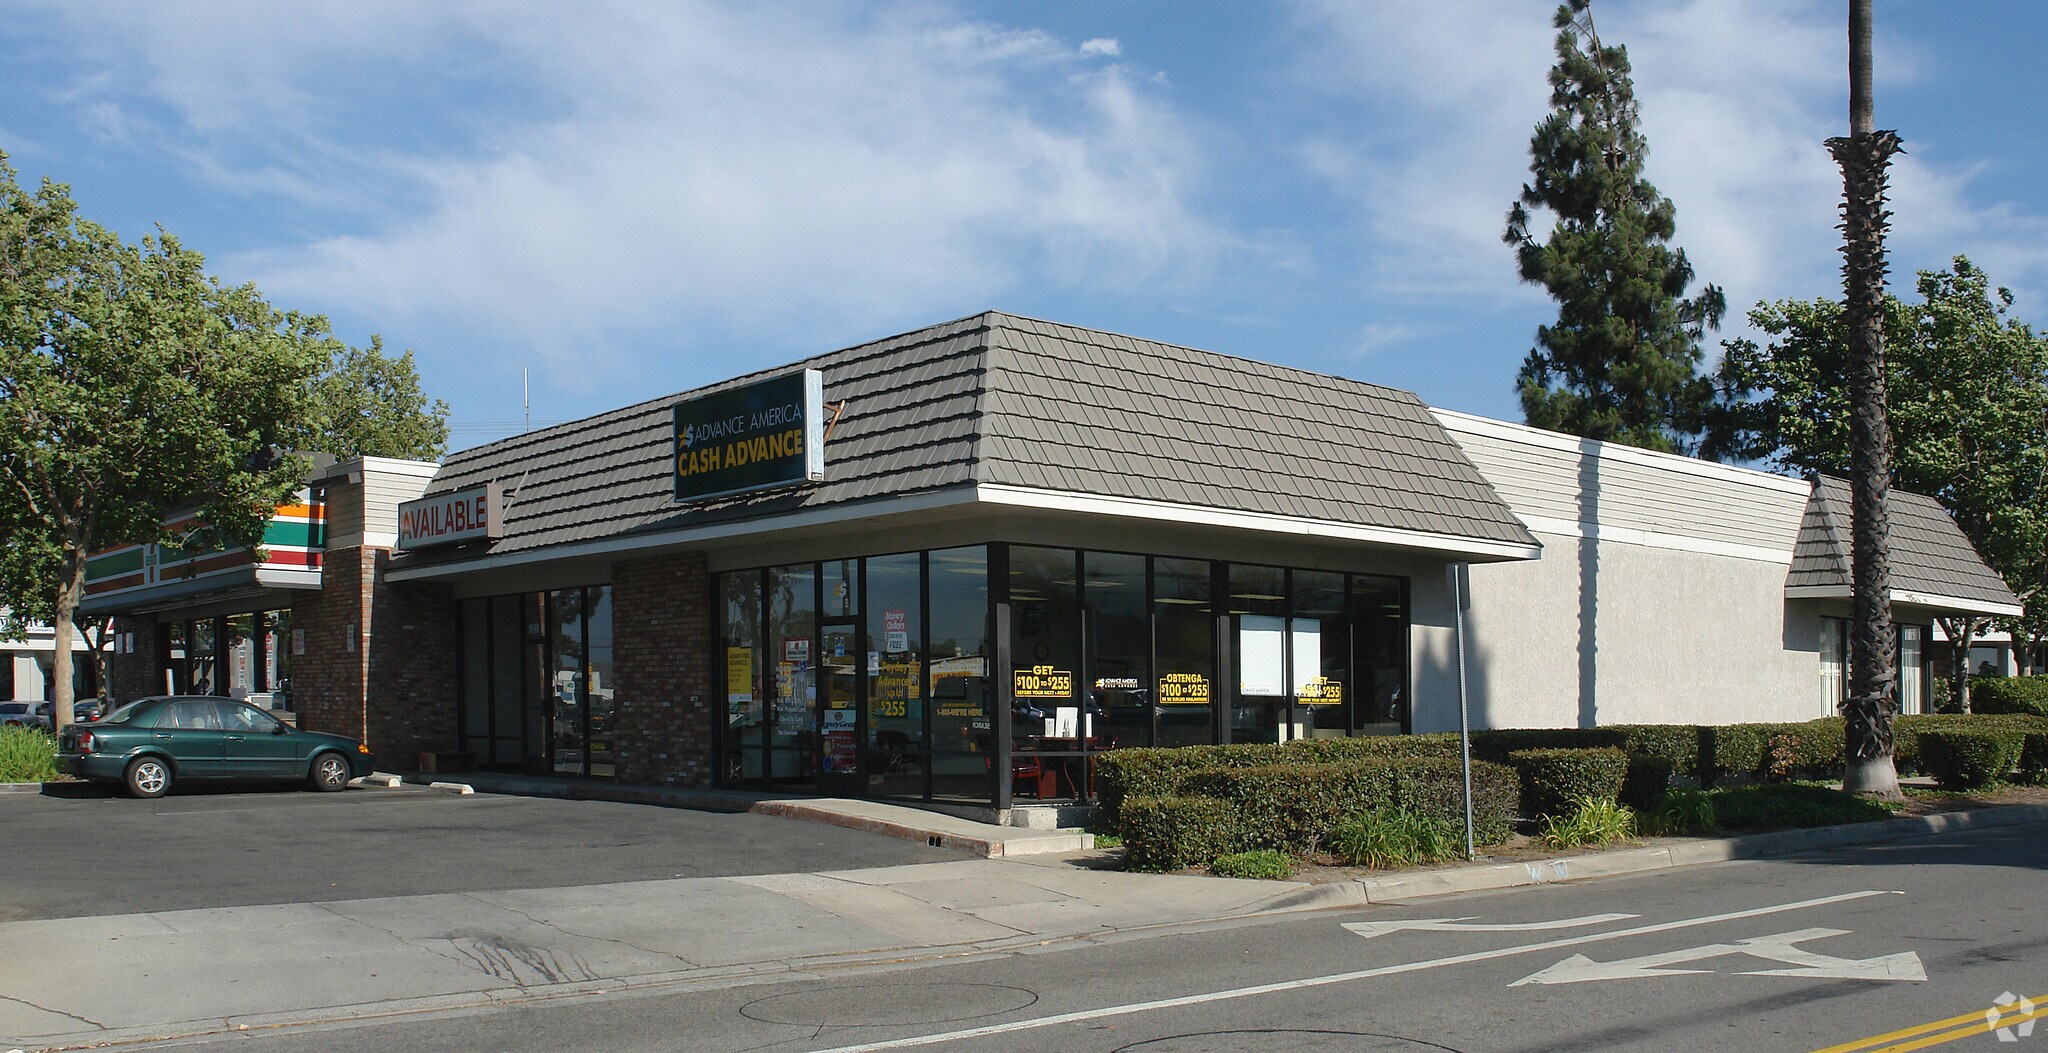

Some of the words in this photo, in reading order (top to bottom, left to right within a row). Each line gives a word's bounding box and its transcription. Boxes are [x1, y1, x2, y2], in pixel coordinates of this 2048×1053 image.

[695, 415, 745, 442] ADVANCE
[750, 403, 802, 430] AMERICA
[678, 446, 720, 477] CASH
[724, 428, 803, 469] ADVANCE
[402, 496, 486, 540] AVAILABLE
[885, 611, 904, 621] Money
[886, 621, 905, 630] Orders
[889, 640, 903, 649] FREE
[881, 661, 908, 674] Payday
[1033, 665, 1054, 675] GET
[1017, 676, 1040, 690] $100
[1048, 676, 1070, 690] $255
[1166, 674, 1203, 683] OBTENGA
[1312, 676, 1328, 685] GET
[1161, 684, 1182, 697] $100
[1188, 684, 1208, 697] $255
[1323, 686, 1340, 698] $255
[881, 700, 905, 717] $255
